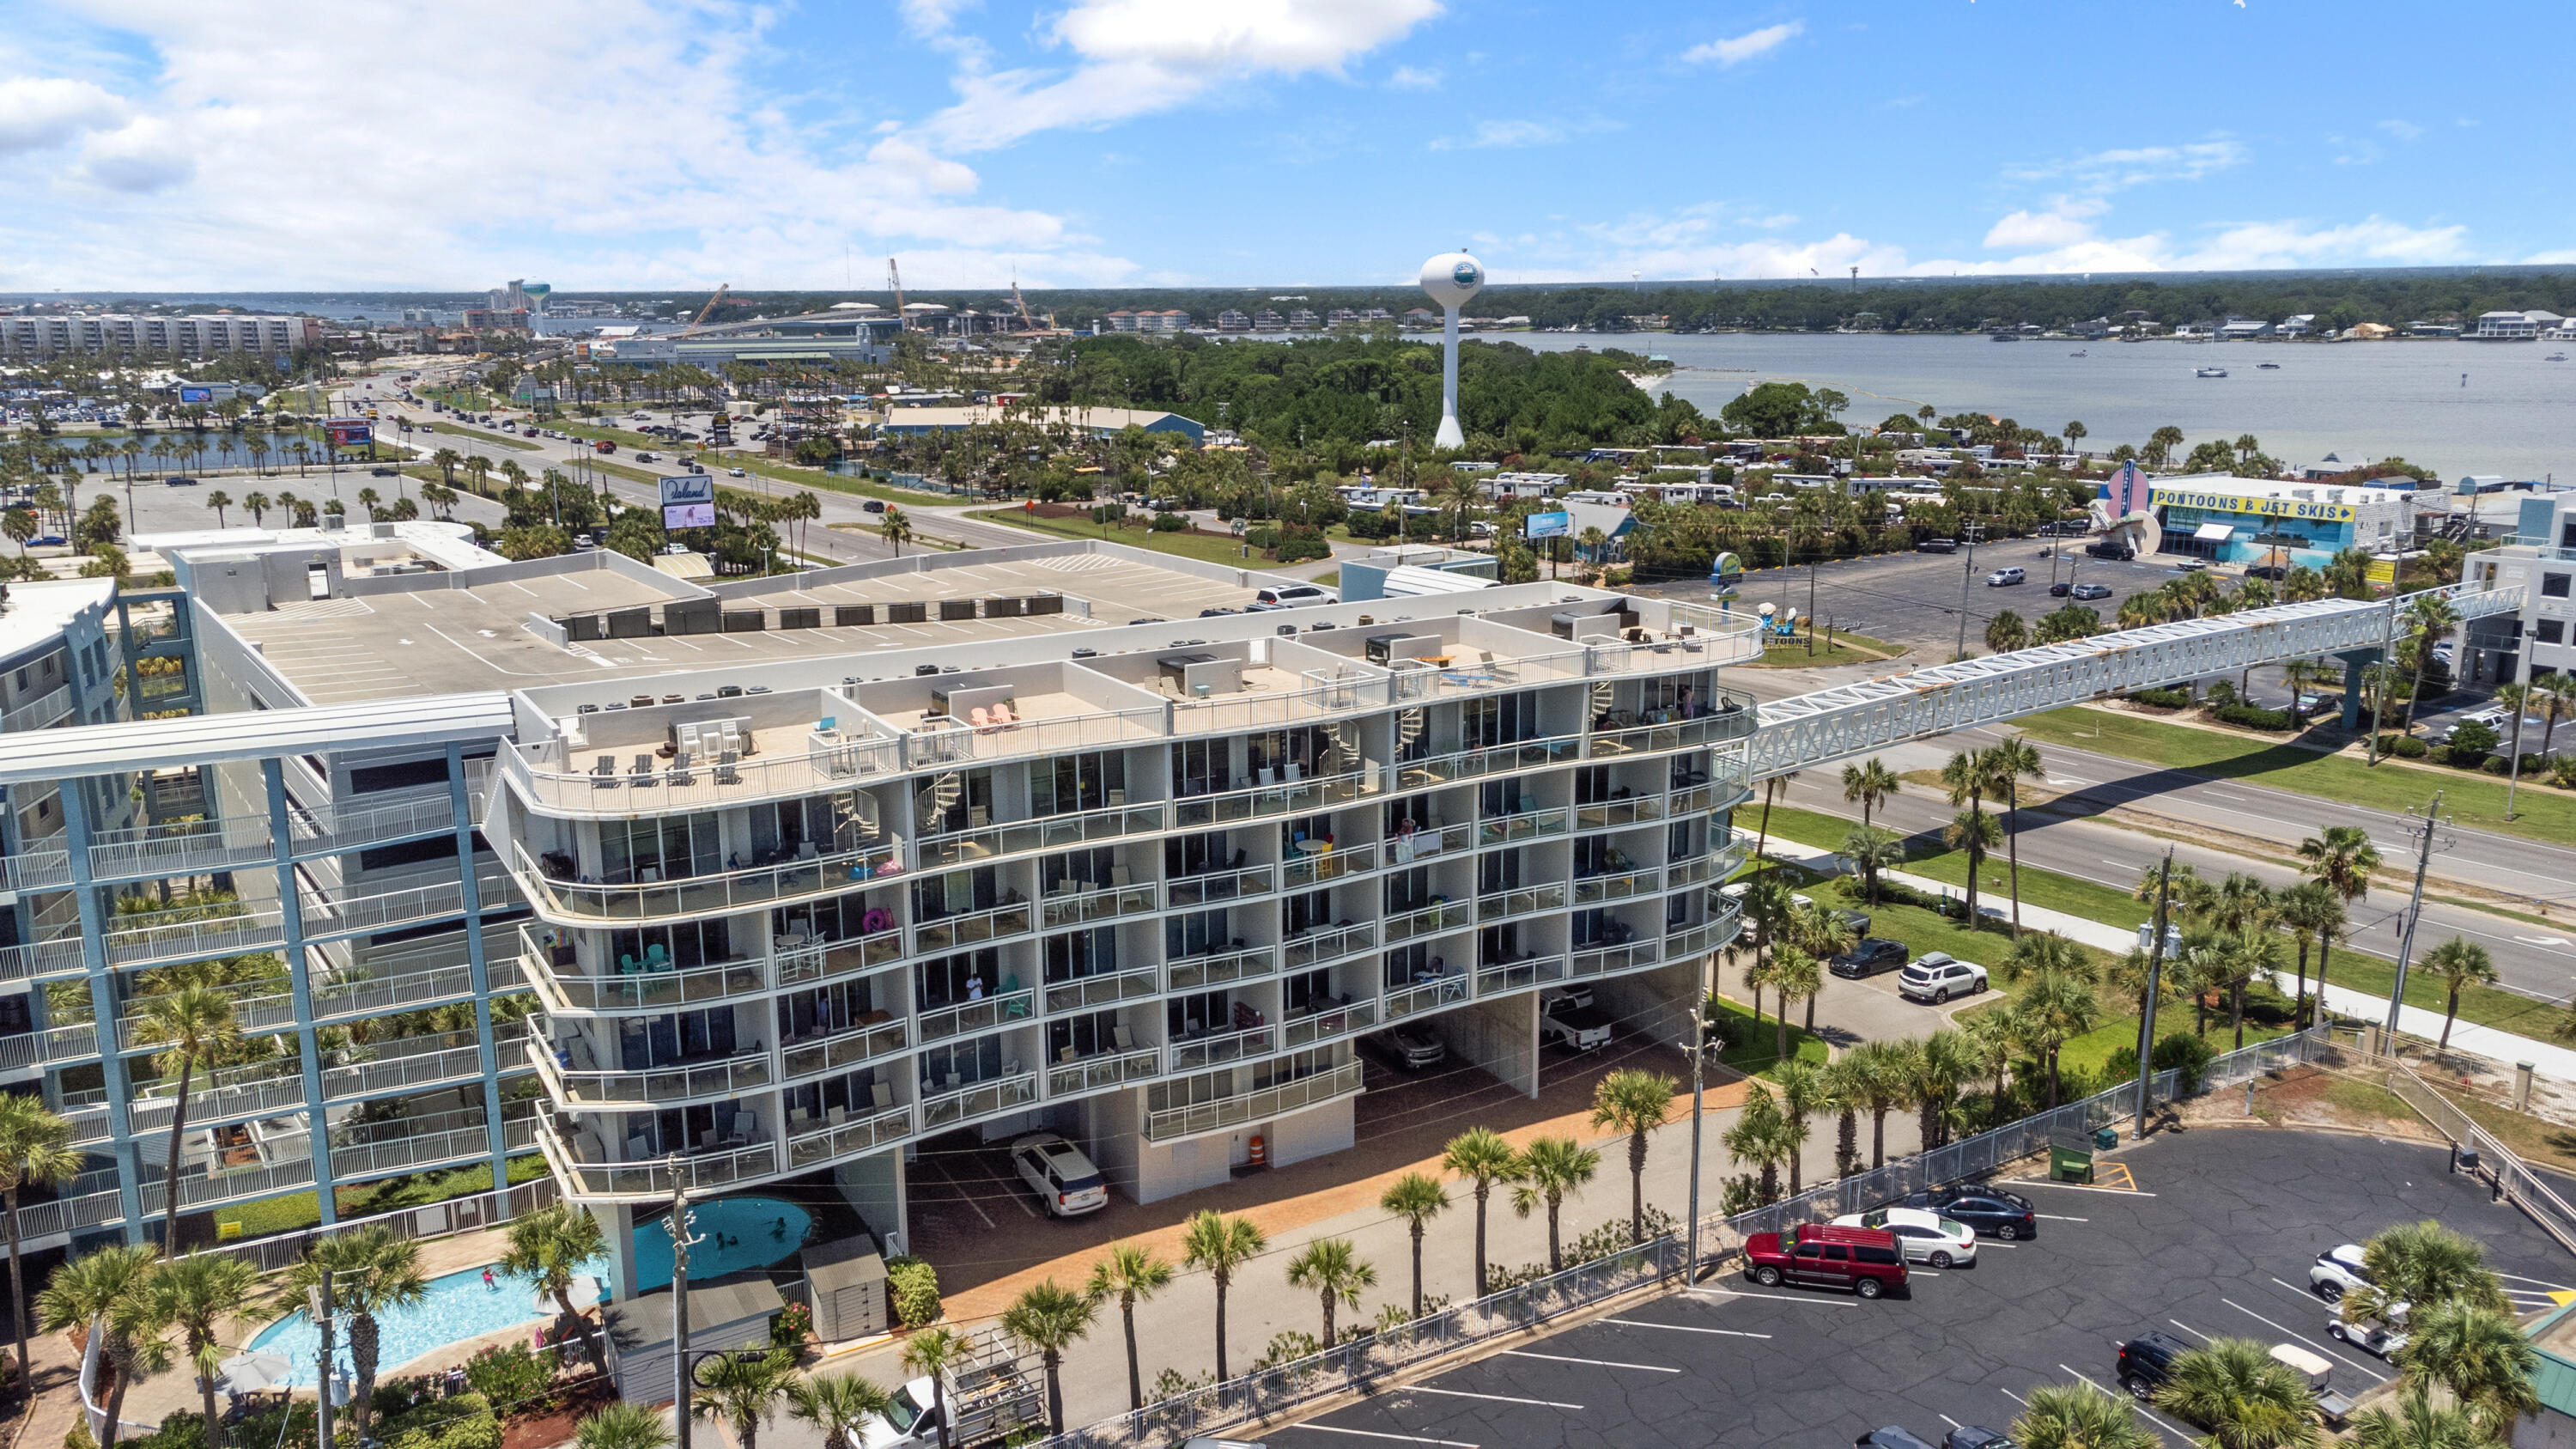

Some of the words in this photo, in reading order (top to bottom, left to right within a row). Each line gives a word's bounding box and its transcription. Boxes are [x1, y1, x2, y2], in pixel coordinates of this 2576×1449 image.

[665, 480, 708, 500] Island
[2157, 491, 2239, 510] PONTOONS
[2245, 500, 2254, 510] &
[2261, 501, 2290, 514] JET
[2297, 503, 2336, 519] SKIS
